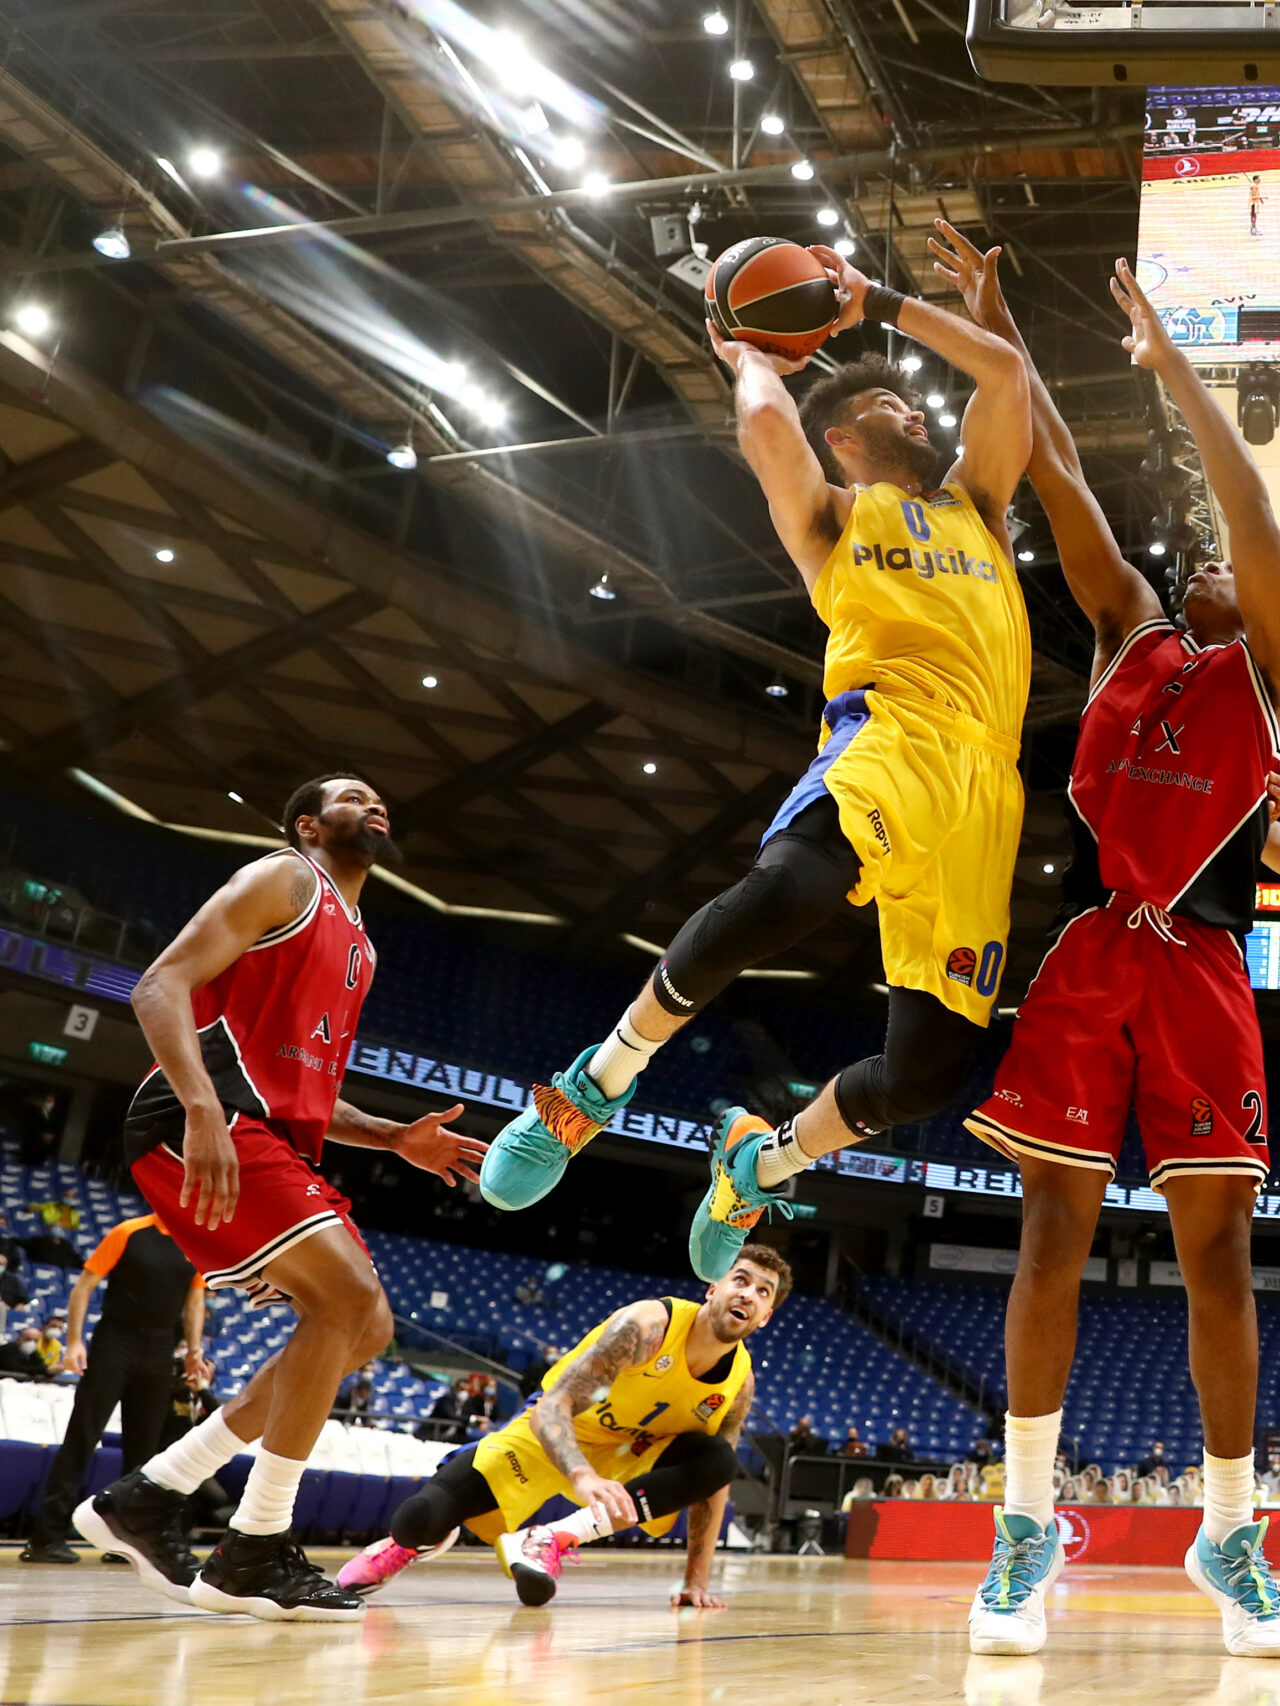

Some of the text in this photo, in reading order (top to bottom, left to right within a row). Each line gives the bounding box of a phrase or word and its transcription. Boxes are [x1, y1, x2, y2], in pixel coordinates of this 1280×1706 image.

[901, 501, 931, 542] 0
[852, 541, 998, 584] Playtika
[1128, 765, 1215, 794] EXCHANGE
[661, 968, 695, 1008] BLINDSAVE
[976, 940, 1004, 997] 0
[74, 1013, 89, 1032] 3
[352, 1040, 535, 1109] ENAULT
[1241, 1090, 1268, 1146] 2
[929, 1199, 939, 1213] 5
[638, 1401, 670, 1427] 1
[505, 1450, 529, 1484] Rapyd
